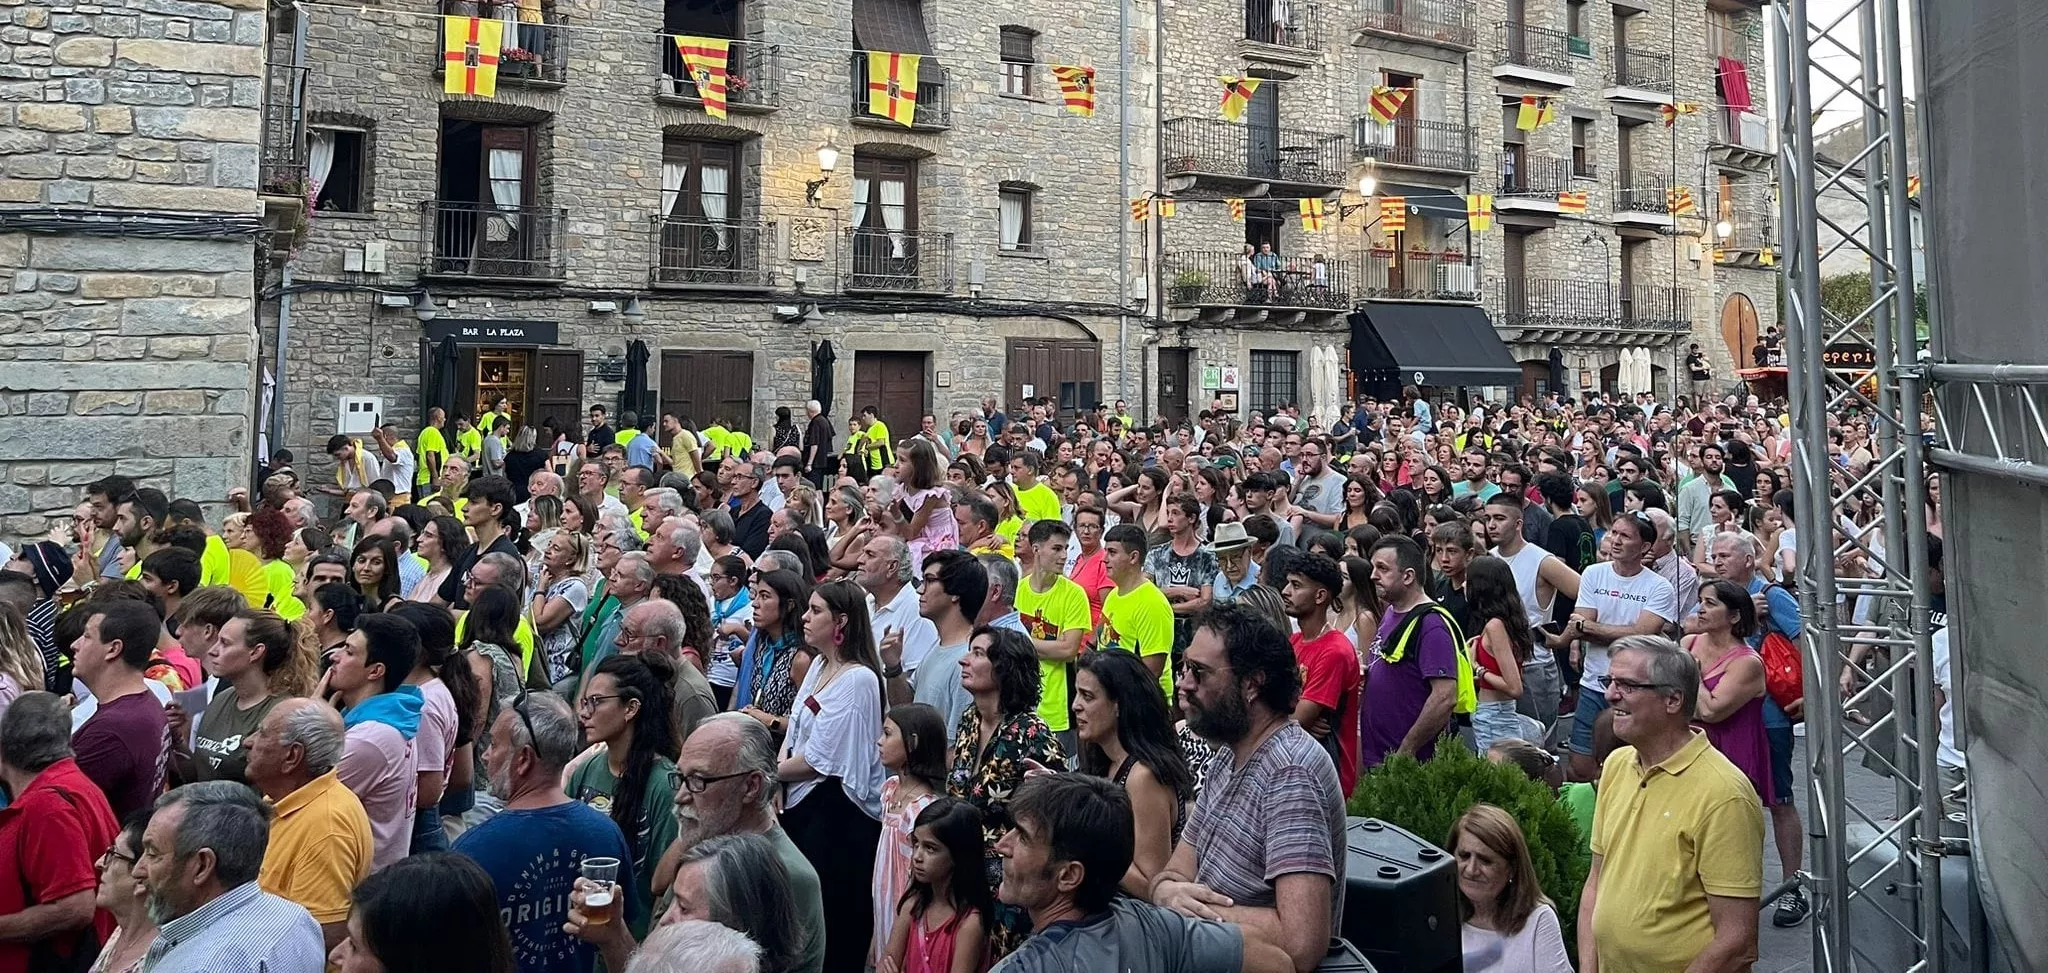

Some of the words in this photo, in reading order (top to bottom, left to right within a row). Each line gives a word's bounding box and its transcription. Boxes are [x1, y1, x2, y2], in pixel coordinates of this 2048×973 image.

[462, 328, 478, 336] BAR
[487, 328, 497, 336] LA
[500, 329, 524, 337] PLAZA
[1823, 348, 1876, 363] eperi
[1620, 593, 1647, 603] JONES
[508, 853, 544, 902] DENIM
[500, 895, 571, 927] ORIGI
